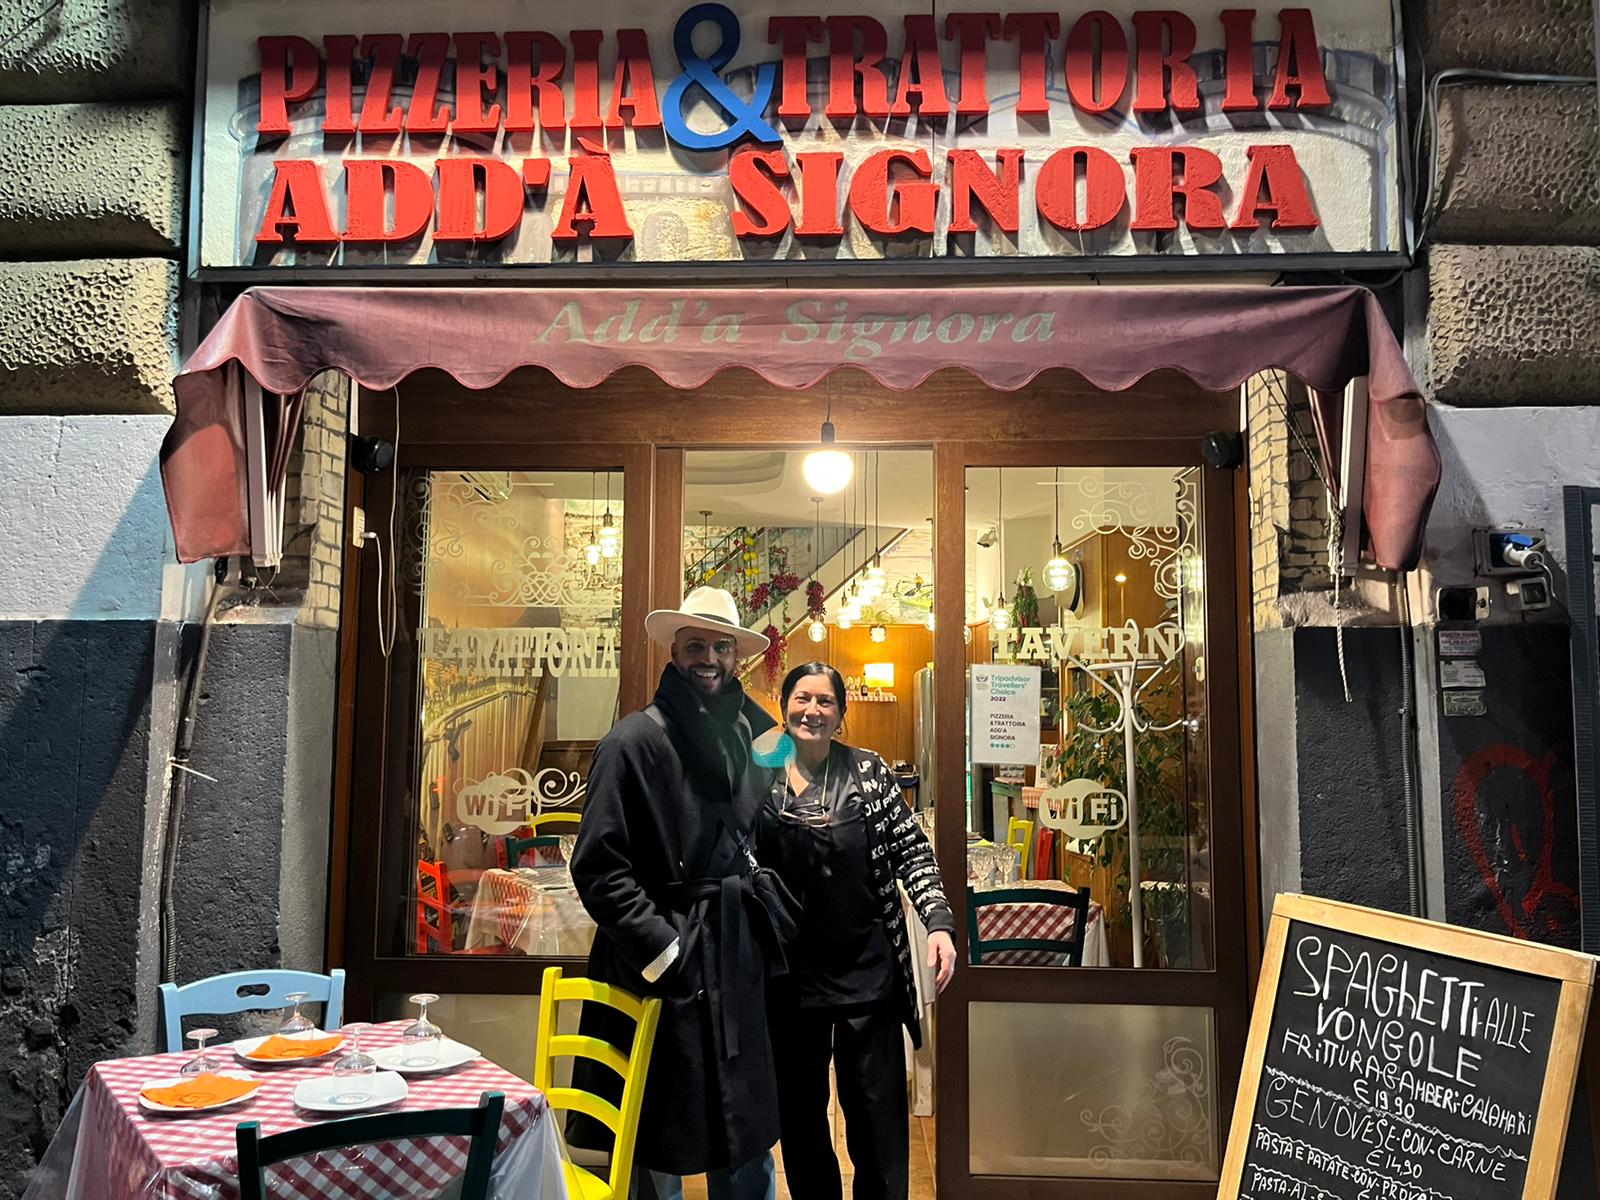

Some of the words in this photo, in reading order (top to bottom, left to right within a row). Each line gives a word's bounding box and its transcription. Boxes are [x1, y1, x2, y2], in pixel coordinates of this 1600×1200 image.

[256, 28, 662, 134] PIZZERIA
[662, 3, 782, 149] &
[768, 9, 1331, 117] TRATTORIA
[729, 144, 1320, 238] SIGNORA
[533, 299, 746, 345] Add'a
[779, 300, 1057, 361] Signora
[988, 627, 1177, 660] TAVERN
[1316, 1003, 1482, 1087] VONGOLE
[1255, 1131, 1293, 1159] PASTA
